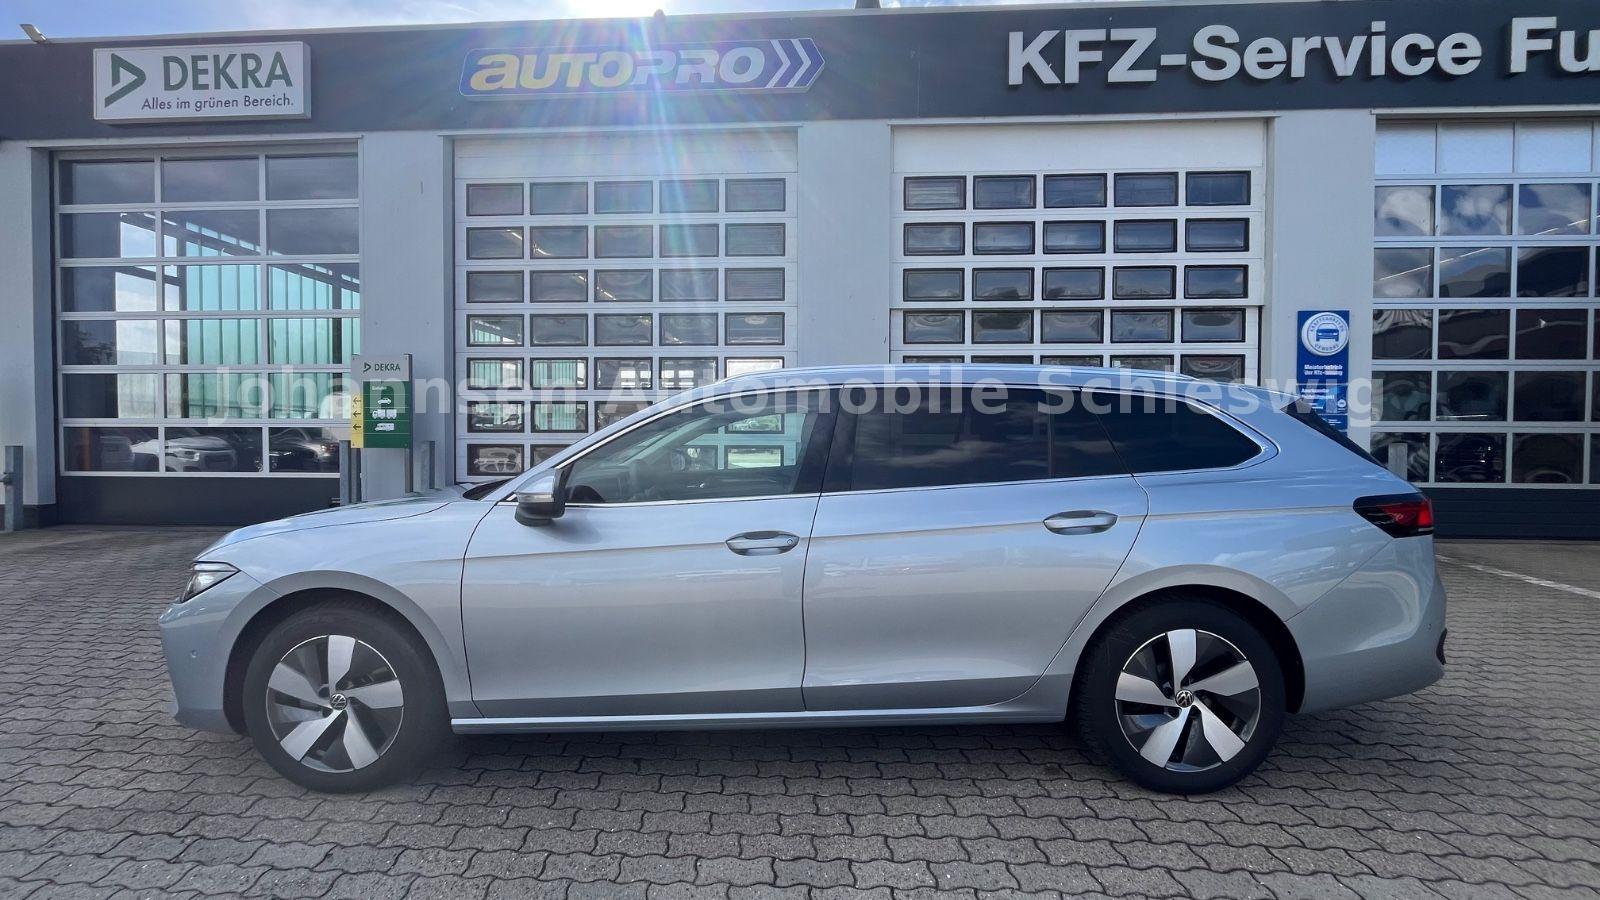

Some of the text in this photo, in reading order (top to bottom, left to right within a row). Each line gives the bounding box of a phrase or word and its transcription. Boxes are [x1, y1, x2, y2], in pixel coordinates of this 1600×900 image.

[1007, 16, 1600, 86] KFZ-Service Fu
[162, 50, 293, 92] DEKRA
[141, 93, 295, 112] Alles im grünen Bereich.
[374, 363, 401, 372] DEKRA
